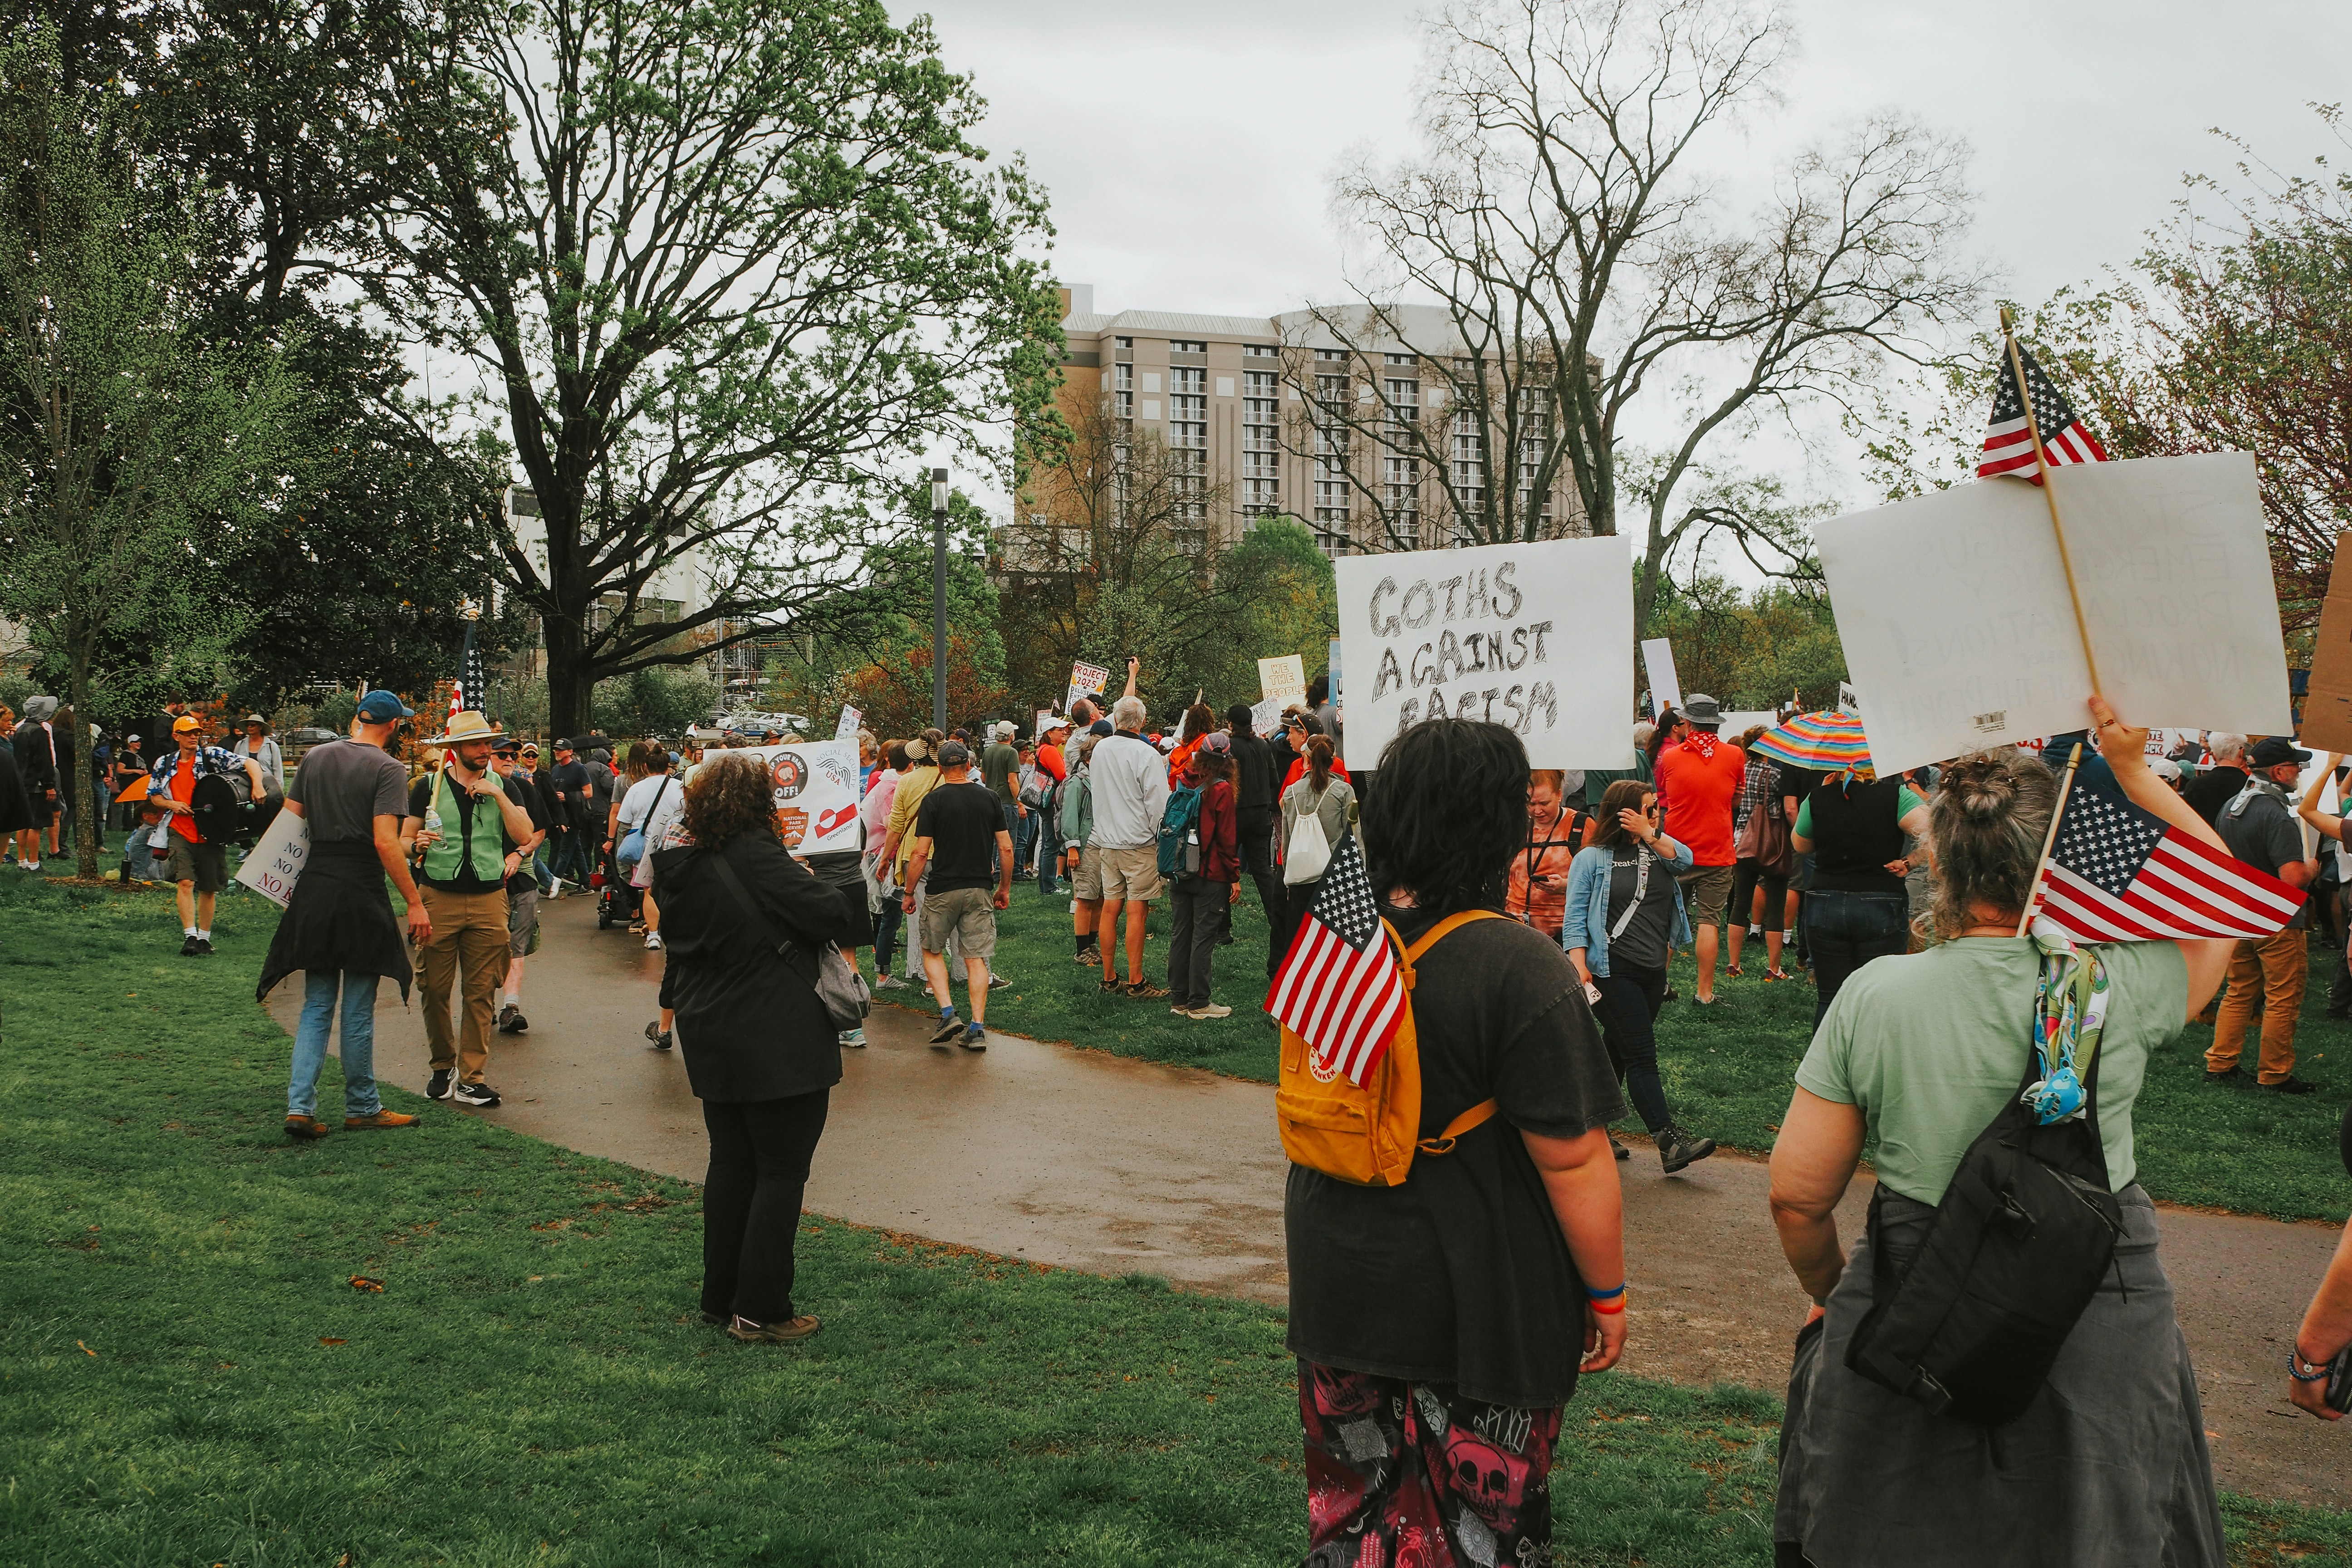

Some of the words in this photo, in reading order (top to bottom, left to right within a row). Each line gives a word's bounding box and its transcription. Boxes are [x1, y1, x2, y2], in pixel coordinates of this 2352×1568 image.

[1369, 562, 1523, 637] GOTHS
[1271, 663, 1289, 674] WE
[1372, 621, 1553, 703] AGAINST
[1074, 665, 1106, 681] PROJECT
[1269, 673, 1294, 685] THE
[1077, 677, 1096, 688] 2025
[1071, 686, 1096, 696] DELUSI
[1264, 685, 1306, 699] PEOPLE
[1841, 689, 1858, 710] HAND
[1251, 716, 1275, 732] TAXES
[775, 754, 791, 763] YOUR
[791, 756, 805, 773] HANDS
[816, 750, 841, 762] SOCIAL
[843, 752, 857, 787] SECURITY
[826, 770, 840, 785] USA
[774, 785, 799, 797] OFF!
[827, 823, 853, 841] Greenland
[284, 842, 303, 858] NO
[273, 858, 293, 874] NO
[257, 872, 282, 892] NO
